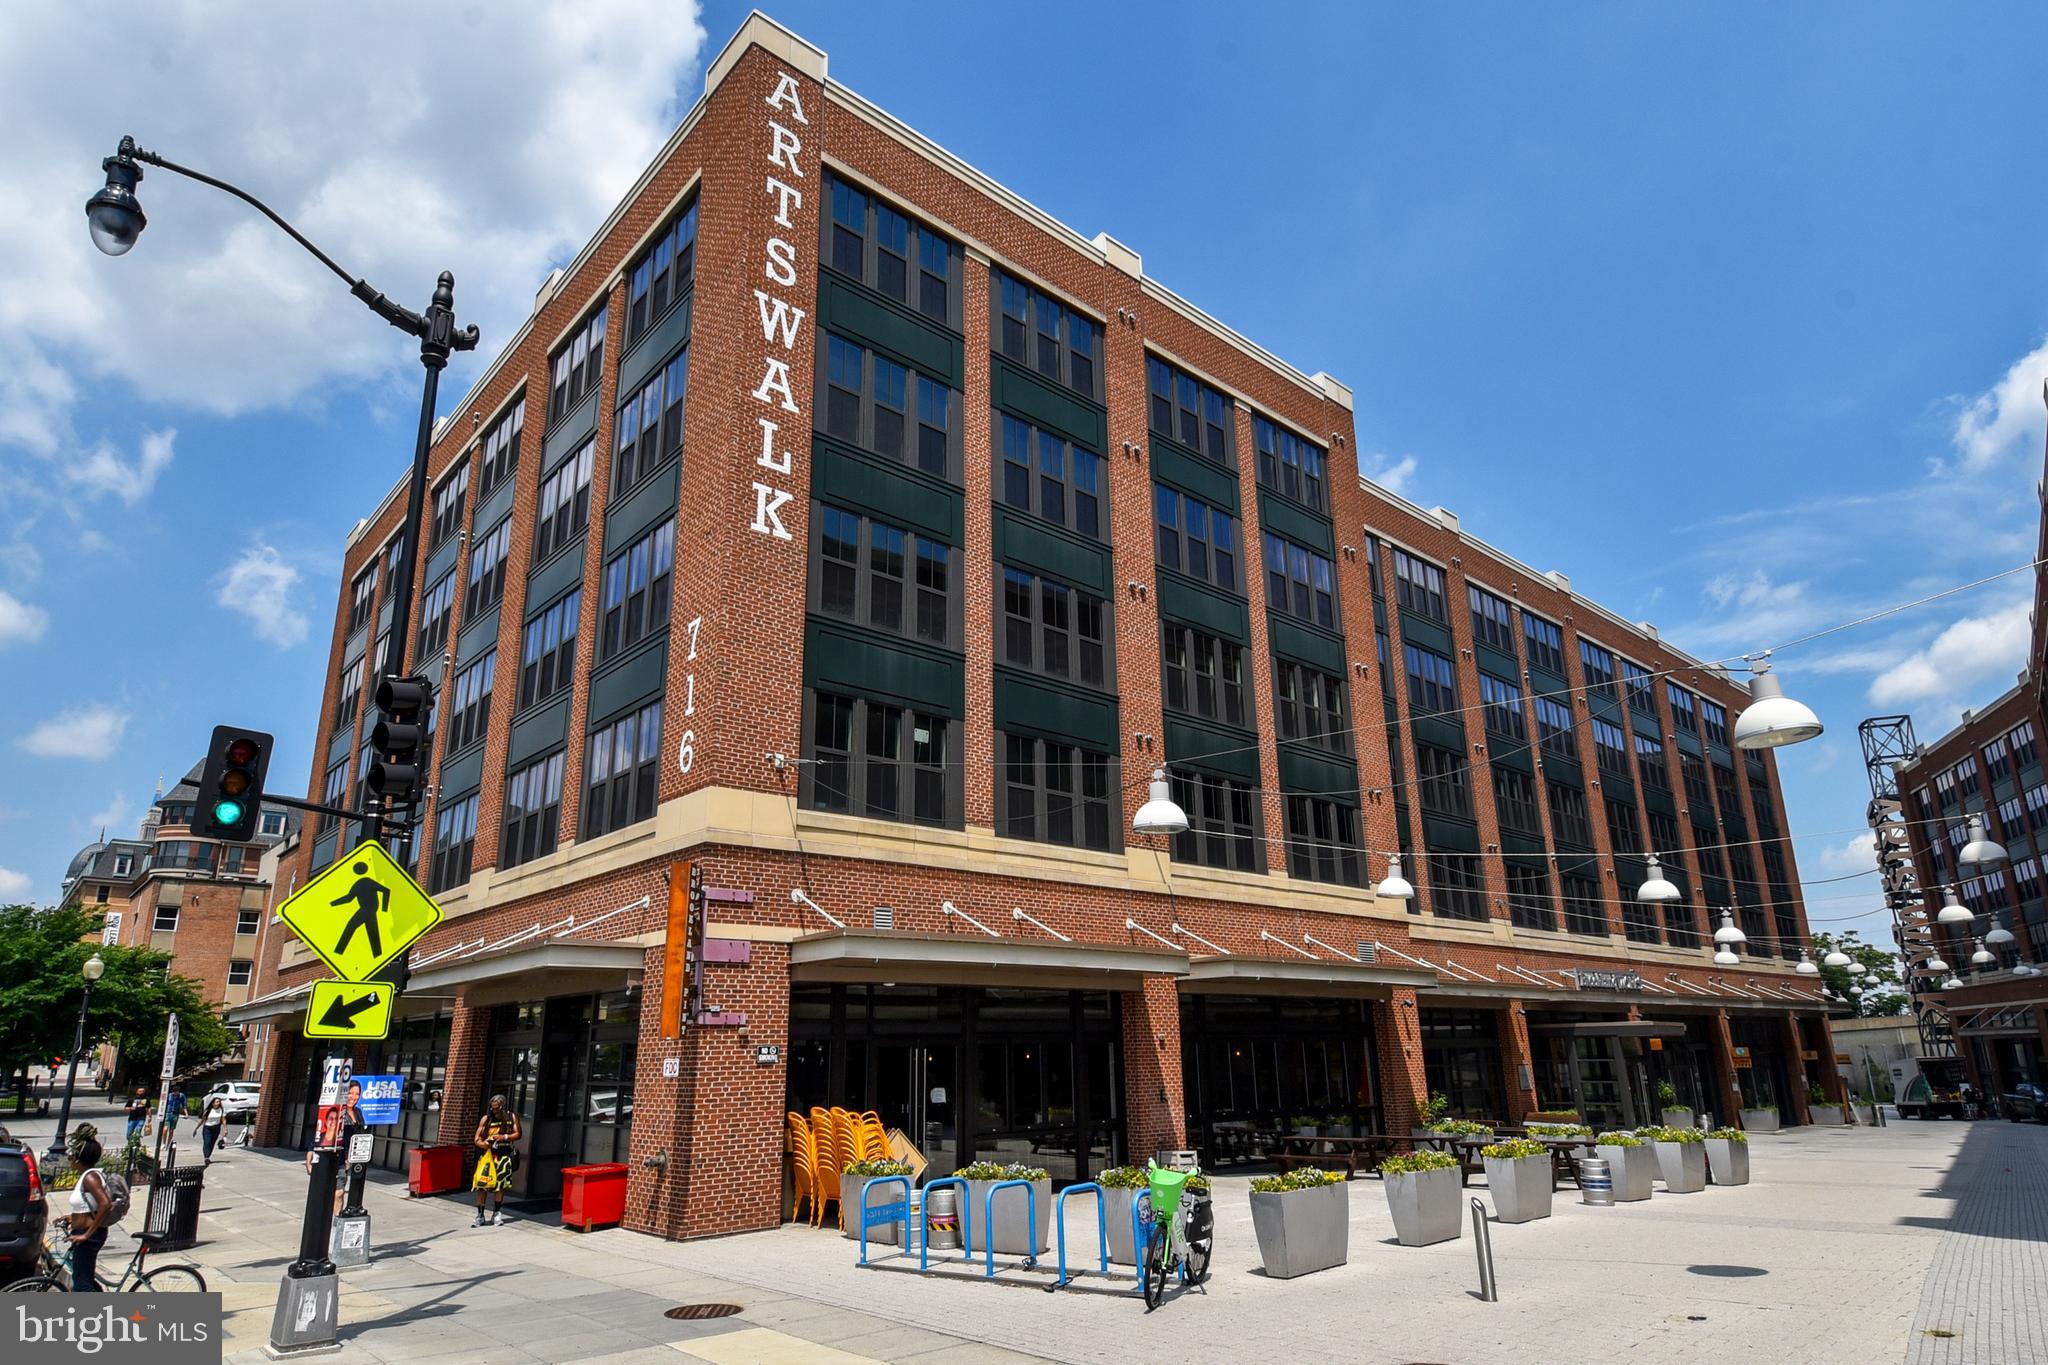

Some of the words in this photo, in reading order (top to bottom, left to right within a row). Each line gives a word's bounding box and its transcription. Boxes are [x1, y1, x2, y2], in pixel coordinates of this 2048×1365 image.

[679, 616, 702, 774] 716
[684, 866, 698, 973] BROOKLAND
[681, 987, 690, 1035] PINT
[665, 1061, 677, 1074] FDC
[362, 1089, 401, 1100] GORE
[367, 1080, 397, 1090] LISA
